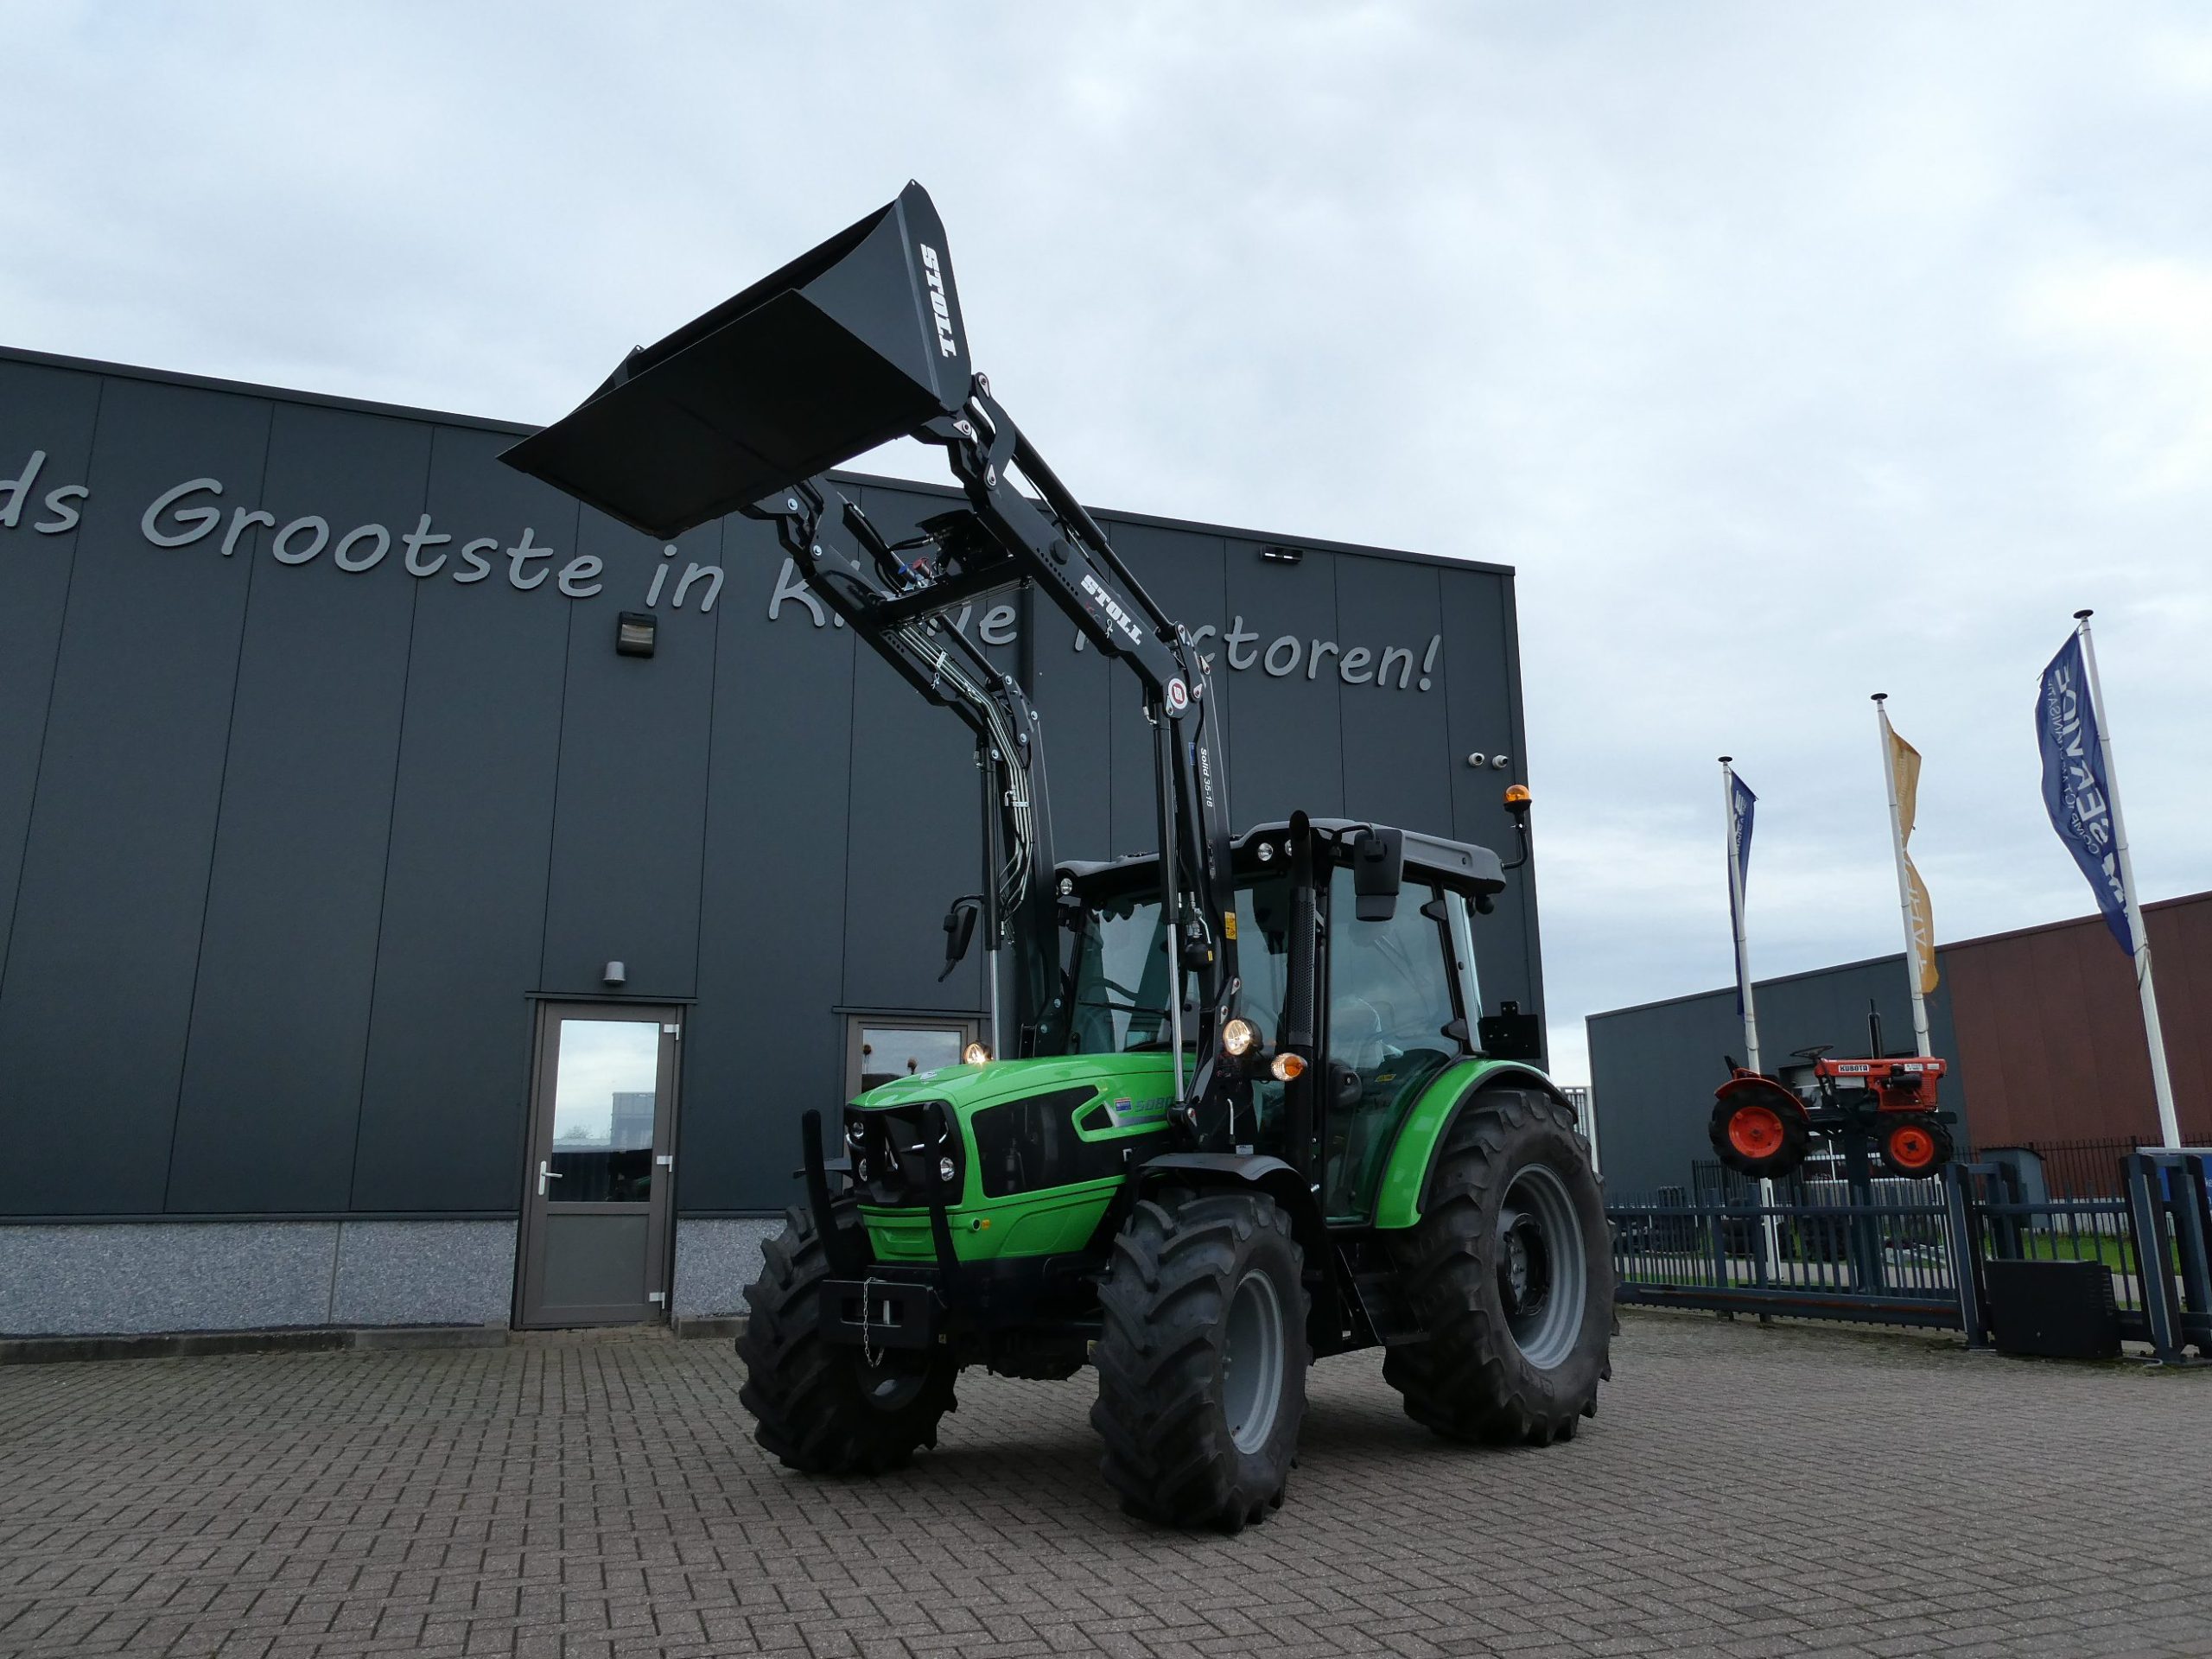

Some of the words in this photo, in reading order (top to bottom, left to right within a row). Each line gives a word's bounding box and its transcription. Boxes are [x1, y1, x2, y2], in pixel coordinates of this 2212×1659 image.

[920, 243, 957, 358] STOLL
[142, 478, 603, 598] Grootste
[646, 544, 725, 613] in
[1080, 574, 1142, 645] STOLL
[1200, 747, 1210, 777] Solid
[1204, 778, 1213, 808] 35-18
